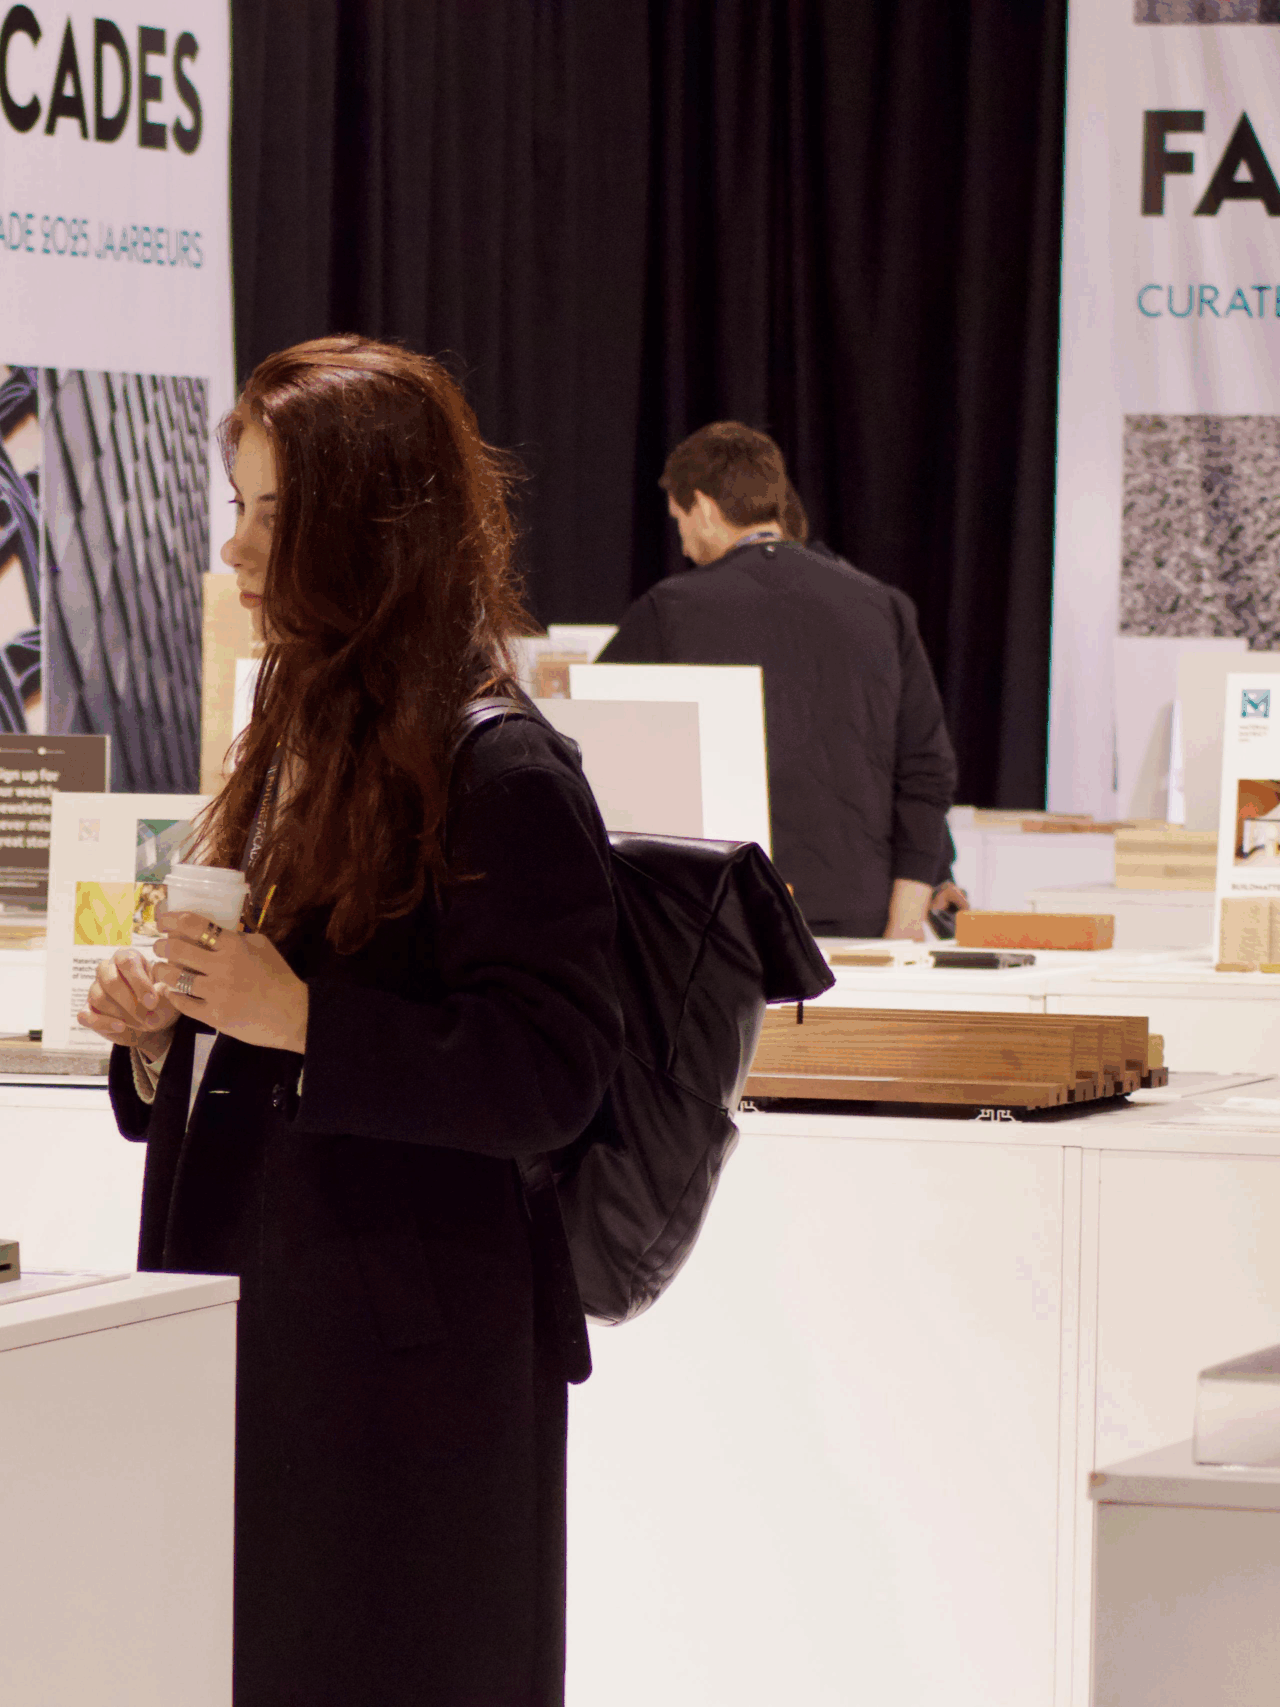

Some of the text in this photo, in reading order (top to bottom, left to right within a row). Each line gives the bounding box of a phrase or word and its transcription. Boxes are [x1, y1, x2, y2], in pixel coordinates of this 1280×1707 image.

[94, 222, 205, 270] JAARBEURS
[1137, 284, 1280, 318] CURAT
[21, 770, 39, 784] up
[39, 767, 60, 783] for
